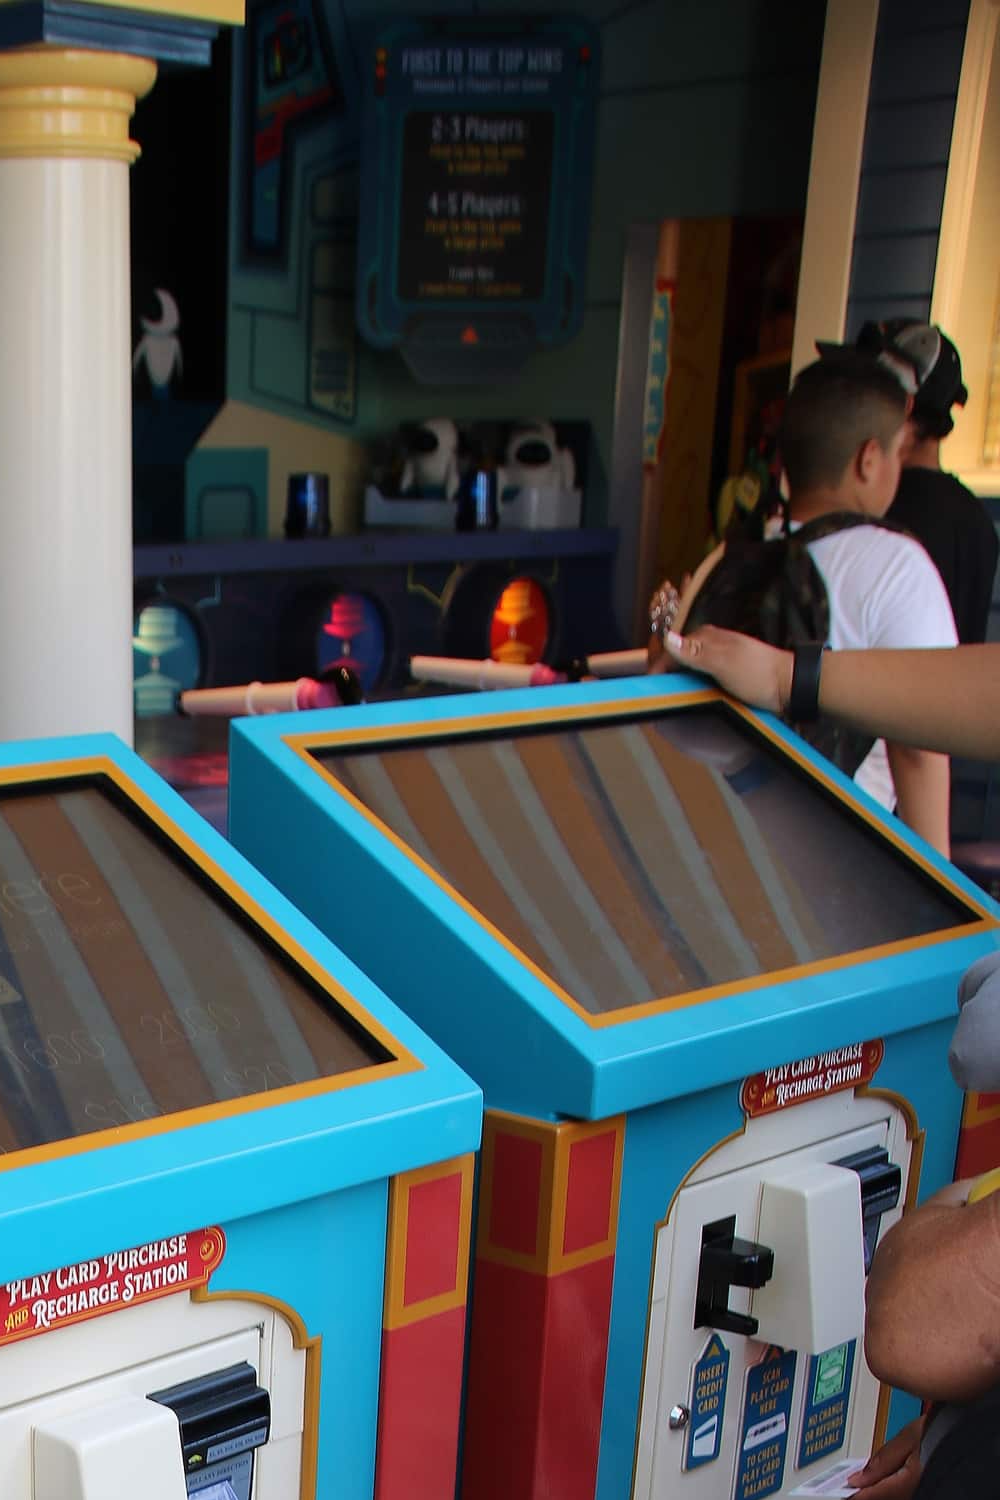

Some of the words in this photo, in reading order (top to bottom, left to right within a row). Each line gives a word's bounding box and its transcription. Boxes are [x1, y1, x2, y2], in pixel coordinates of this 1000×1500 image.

[791, 1057, 815, 1078] CARD
[776, 1075, 823, 1106] RECHARGE
[824, 1063, 862, 1092] STATION
[6, 1273, 51, 1305] PLAY
[56, 1261, 100, 1290] CARD
[104, 1235, 187, 1277] PURCHASE
[32, 1281, 120, 1329] RECHARGE
[122, 1260, 188, 1301] STATION
[698, 1362, 725, 1383] INSERT
[763, 1367, 781, 1384] SCAN
[696, 1378, 723, 1399] CREDIT
[751, 1386, 770, 1405] PLAY
[771, 1377, 789, 1395] CARD
[698, 1397, 719, 1414] CARD
[747, 1452, 756, 1464] TO
[757, 1443, 779, 1462] CHECK
[742, 1466, 761, 1484] PLAY
[762, 1457, 780, 1475] CARD
[744, 1475, 775, 1498] BALANCE
